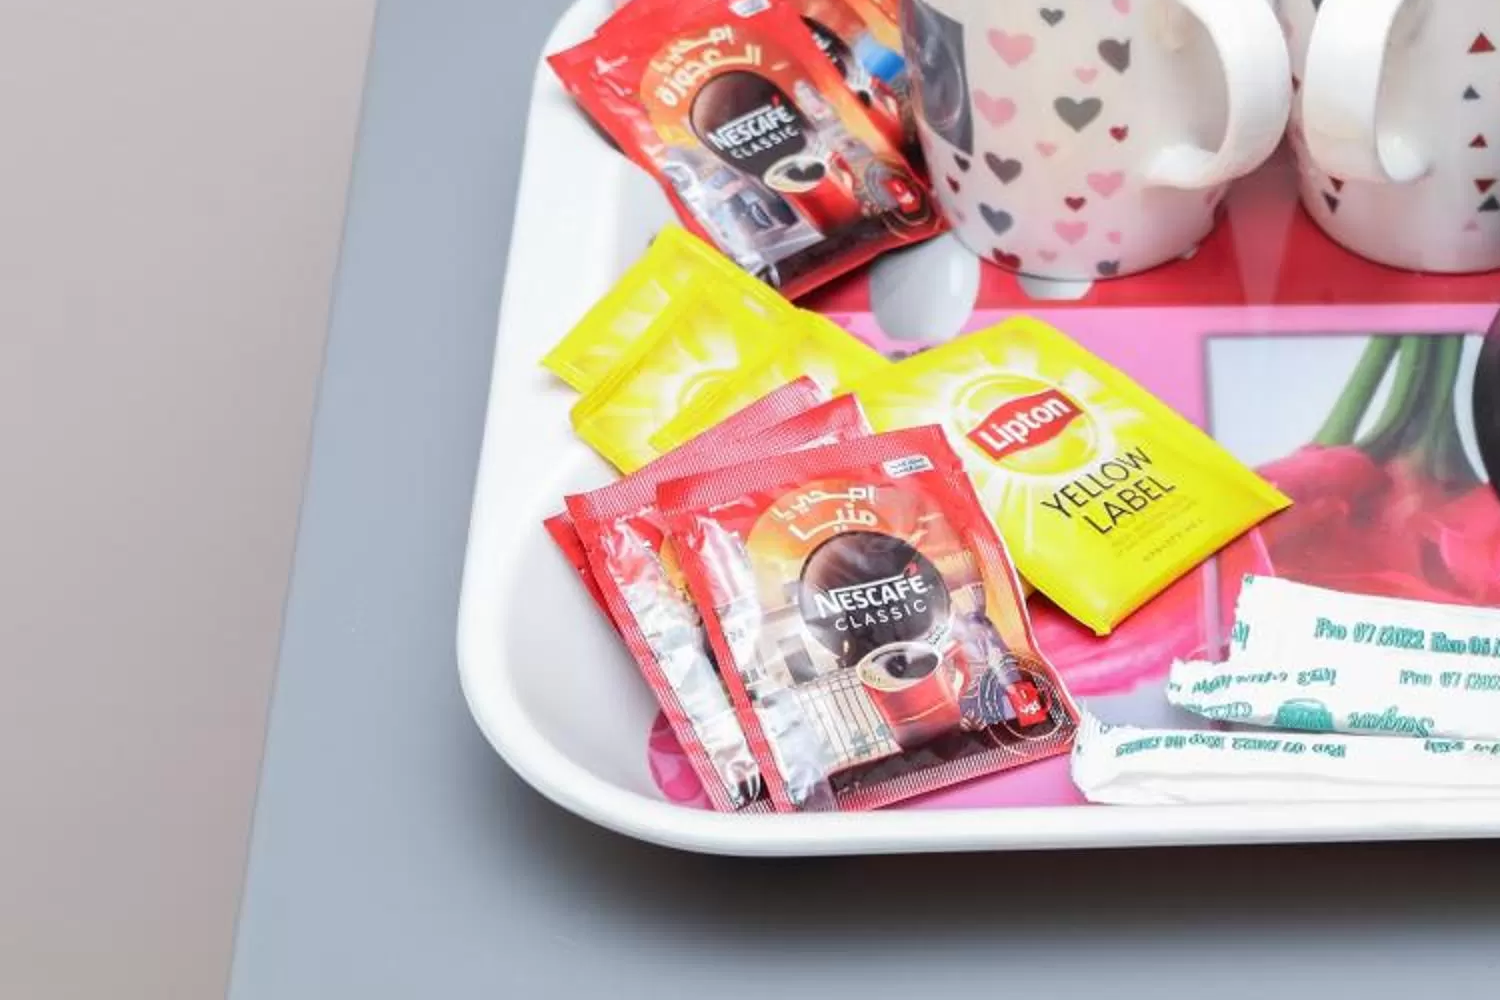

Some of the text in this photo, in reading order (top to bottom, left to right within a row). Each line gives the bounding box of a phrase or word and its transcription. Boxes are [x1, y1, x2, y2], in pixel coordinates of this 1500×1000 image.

[729, 125, 799, 160] CLASSIC
[978, 396, 1073, 452] Lipton
[1039, 446, 1154, 520] YELLOW
[1083, 474, 1177, 536] LABEL
[833, 598, 928, 632] CLASSIC
